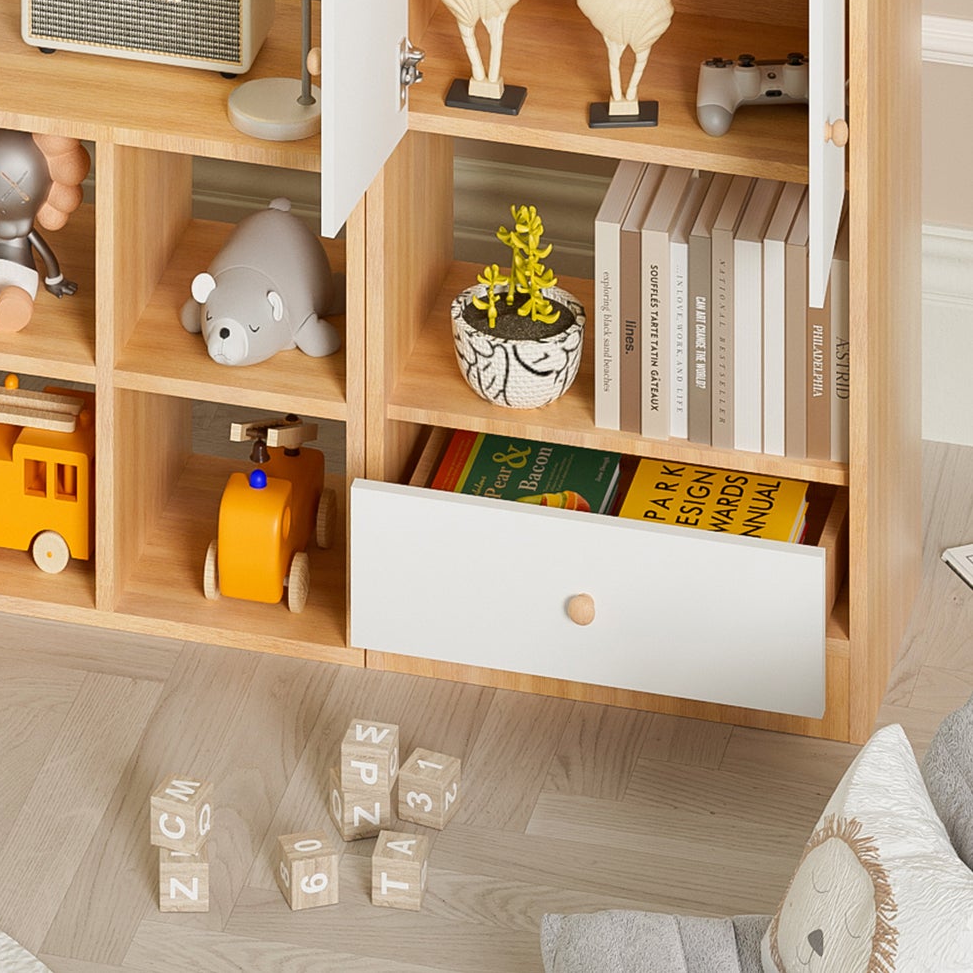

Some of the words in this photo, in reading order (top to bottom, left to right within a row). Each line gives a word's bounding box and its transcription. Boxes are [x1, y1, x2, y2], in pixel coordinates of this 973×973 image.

[601, 271, 612, 312] exploring
[695, 296, 706, 309] CAN
[718, 259, 726, 329] NATIONAL
[603, 313, 613, 336] black
[625, 319, 637, 355] lines.
[650, 310, 659, 338] TARTE
[695, 324, 706, 349] CHANGE
[603, 338, 613, 359] sand
[650, 340, 659, 367] TATIN
[695, 349, 706, 362] THE
[812, 324, 824, 397] PHILADELPHIA
[603, 358, 614, 392] beaches
[676, 360, 684, 383] AND
[718, 336, 726, 425] BESTSELLER
[676, 387, 684, 414] LIFE
[492, 444, 532, 469] &
[518, 446, 554, 492] Bacon
[484, 466, 512, 499] Pear
[643, 464, 686, 521] PARK
[675, 470, 718, 527] ESIGN
[350, 760, 378, 785] P
[406, 791, 433, 812] 3
[158, 812, 186, 840] C
[386, 839, 417, 856] A
[381, 872, 409, 895] T
